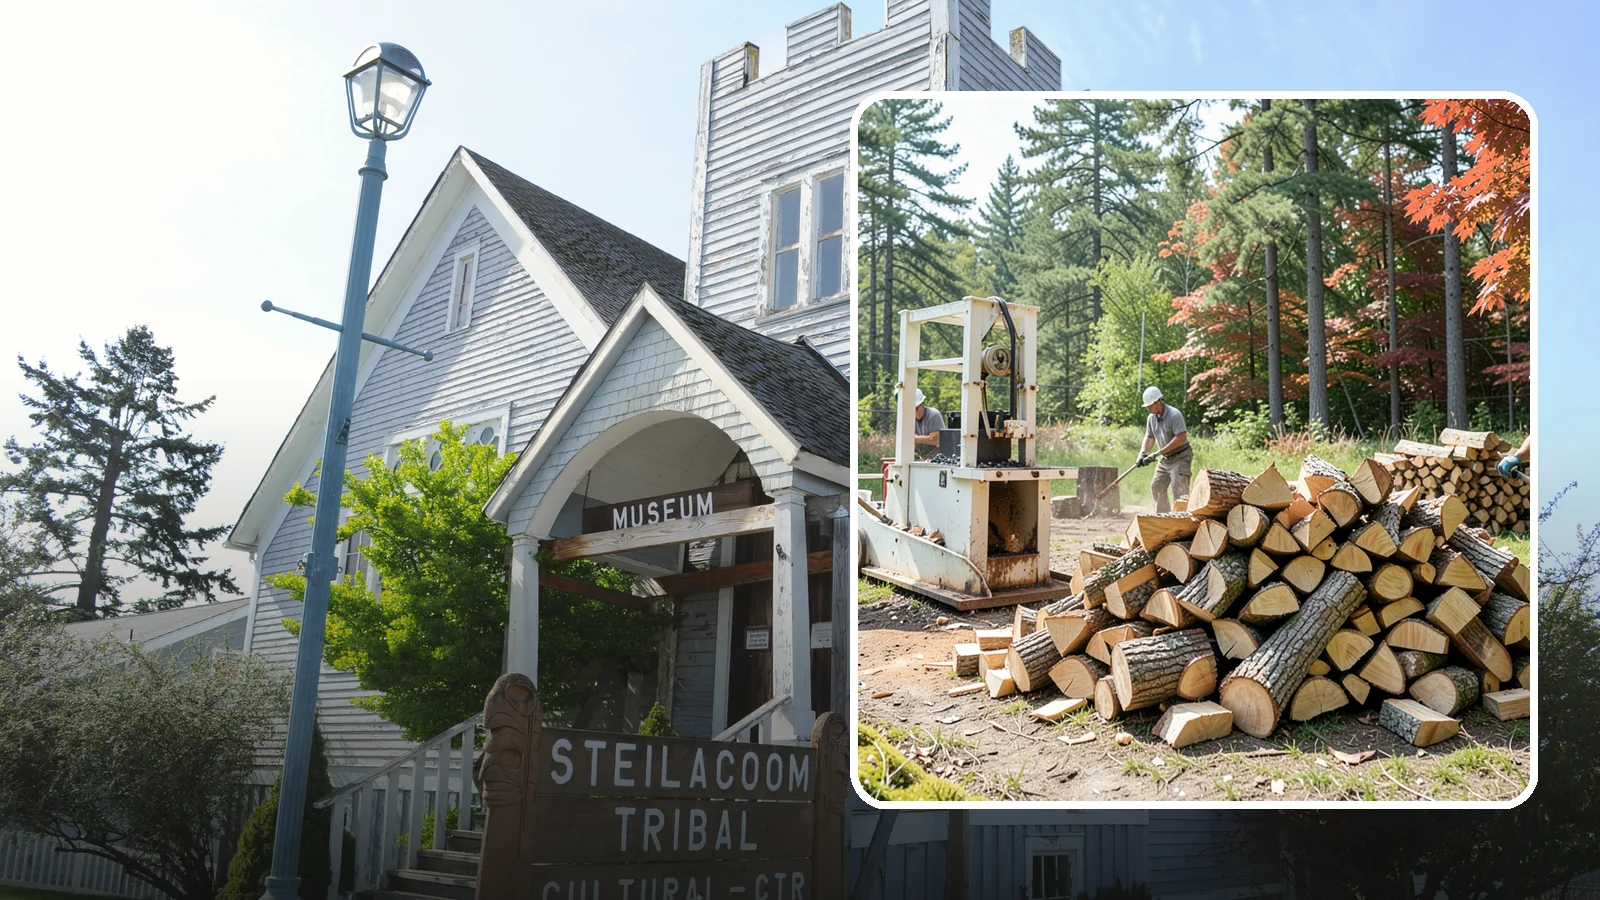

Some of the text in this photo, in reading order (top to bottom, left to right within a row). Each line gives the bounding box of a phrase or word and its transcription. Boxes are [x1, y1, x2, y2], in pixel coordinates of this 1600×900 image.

[613, 491, 714, 530] MUSEUM
[550, 738, 810, 793] STEILACOOM
[614, 806, 758, 852] TRIBAL
